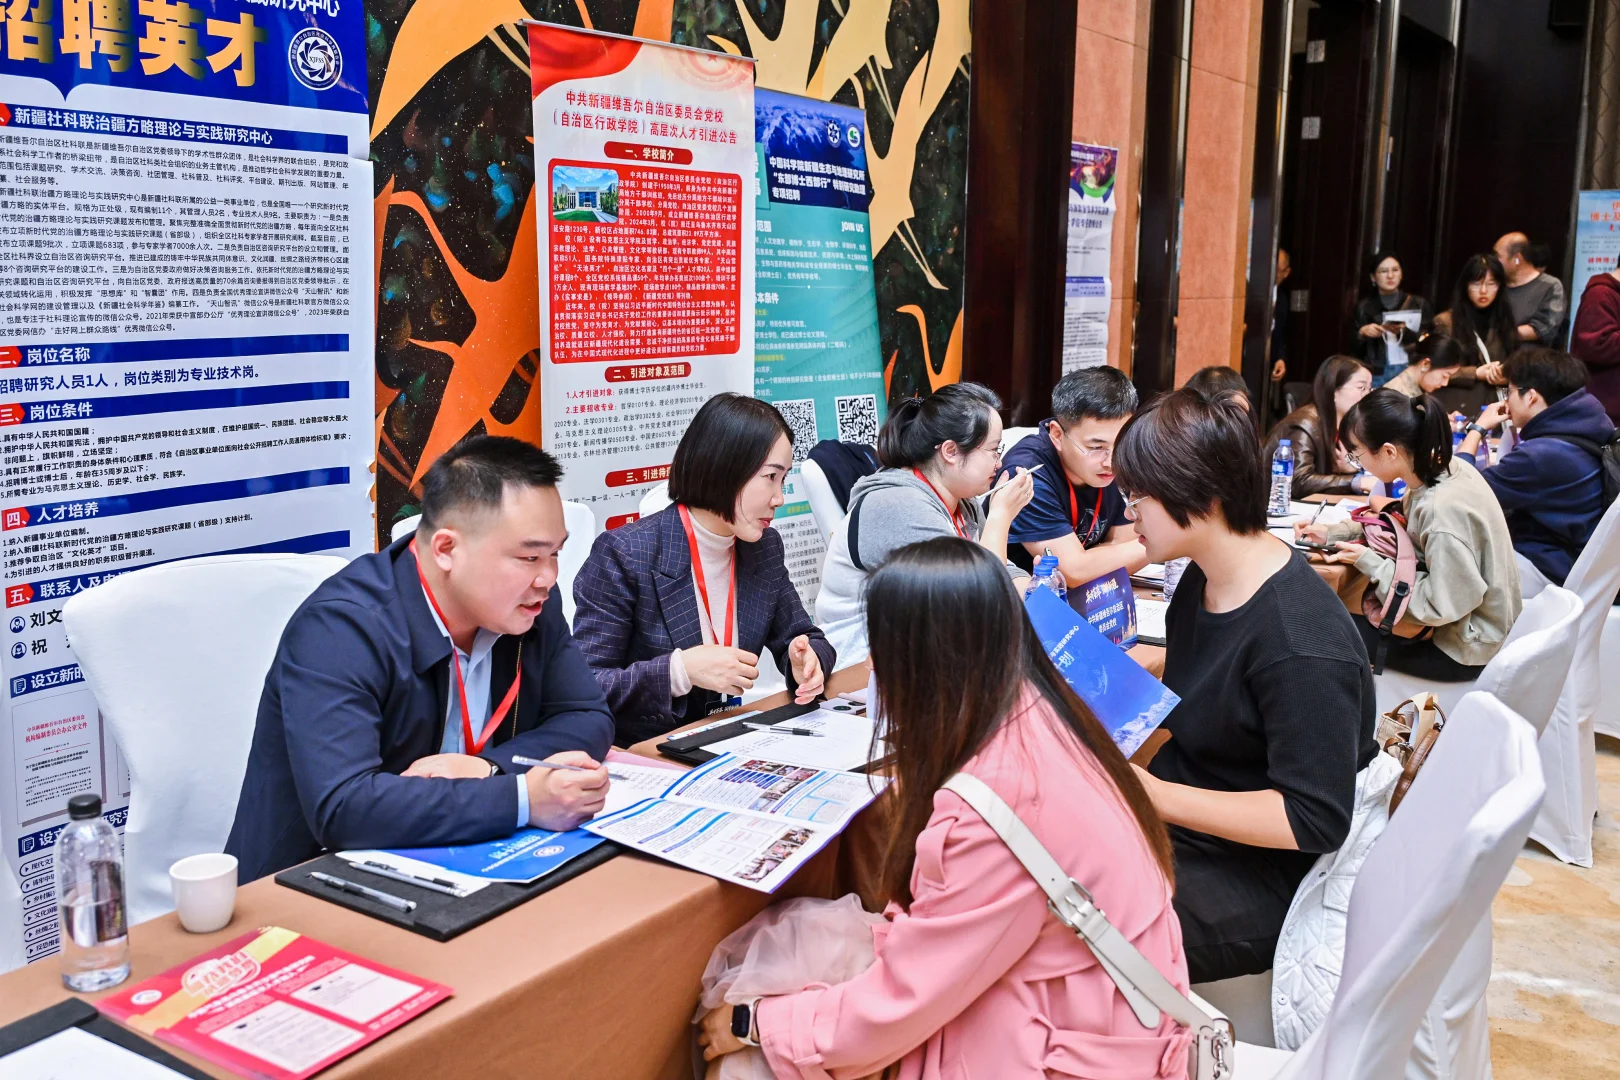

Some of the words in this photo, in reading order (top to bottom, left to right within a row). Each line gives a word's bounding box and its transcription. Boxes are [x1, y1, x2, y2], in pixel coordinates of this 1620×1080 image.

[566, 90, 724, 123] 中共新疆维吾尔自治区委员会党校
[15, 108, 273, 145] 新疆社科联治疆方略理论与实践研究中心
[553, 109, 738, 145] （自治区行政学院）高层次人才引进公告
[625, 147, 675, 162] 一、学校简介
[0, 200, 349, 222] 疆方略的实体平台。规格为正处级，现有编制11个，其管理人员2名，专业技术人员9名。主要职责为：一是负责
[0, 214, 349, 232] 代党的治疆方略理论与实践研究课题发布和管理。聚焦完整准确全面贯彻新时代党的治疆方略，每年面向全区社科
[755, 220, 772, 232] 范围
[856, 222, 865, 233] US
[27, 347, 91, 364] 岗位名称
[613, 364, 685, 379] 二、引进对象及范围
[30, 402, 93, 421] 岗位条件
[37, 501, 99, 522] 人才培养
[31, 639, 48, 655] 祝
